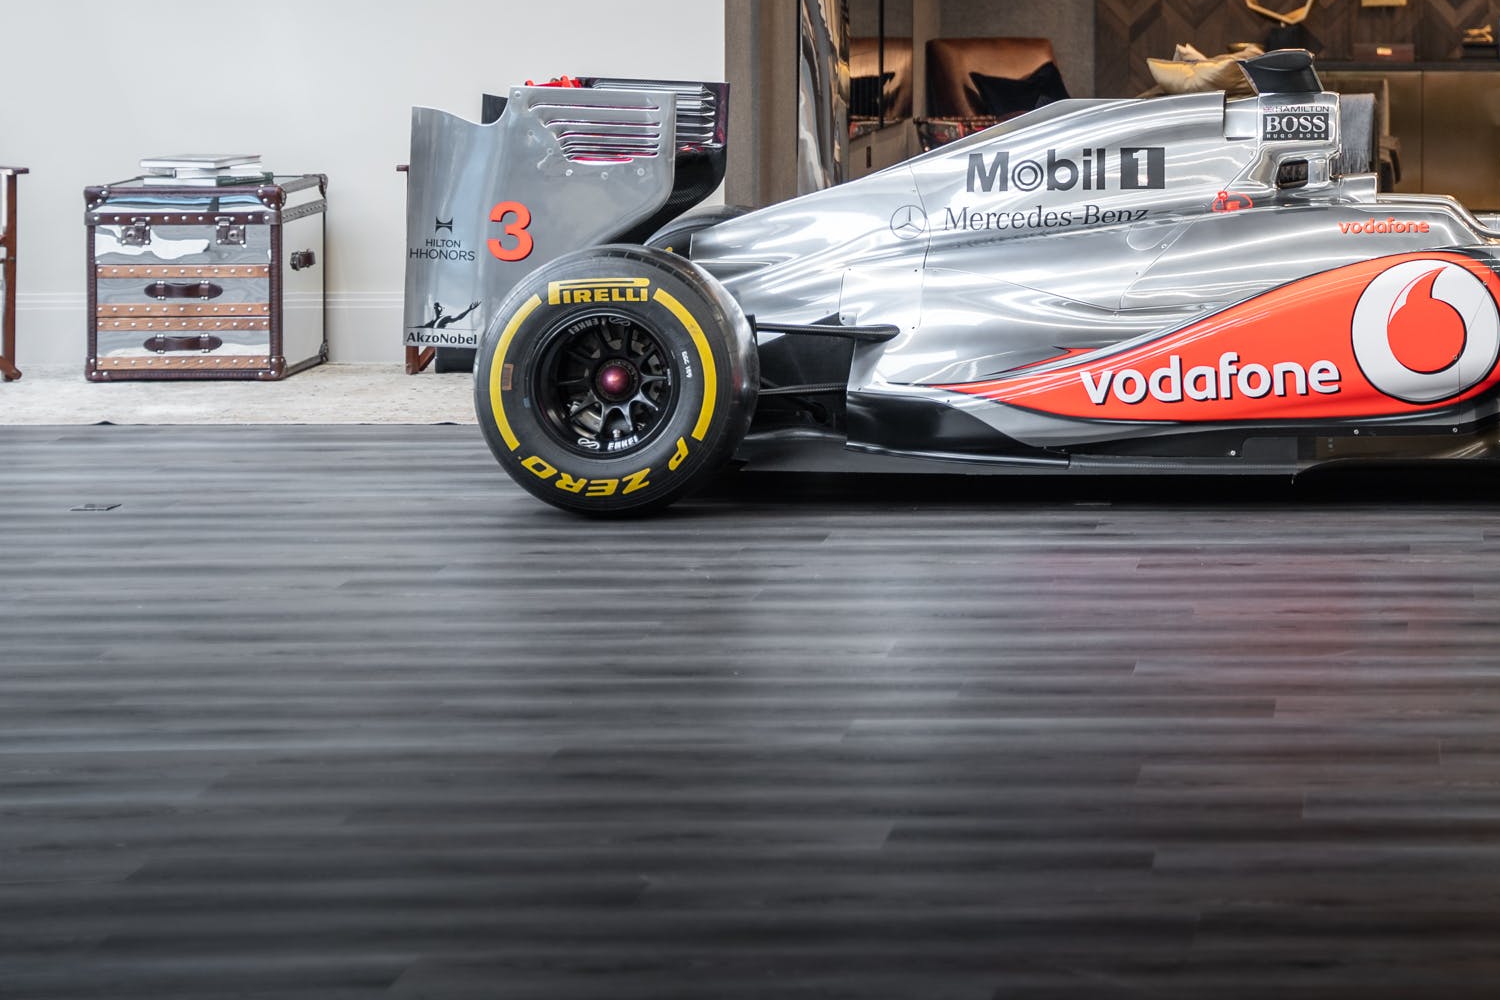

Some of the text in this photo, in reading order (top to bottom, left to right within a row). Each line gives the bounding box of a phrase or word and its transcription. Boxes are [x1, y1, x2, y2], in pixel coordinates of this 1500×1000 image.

[1265, 115, 1326, 133] BOSS
[966, 147, 1106, 193] Mobil
[943, 204, 1149, 231] Mercedes-Benz
[1338, 216, 1430, 235] vodafone
[425, 238, 461, 248] HILTON
[486, 201, 534, 262] 3
[409, 247, 476, 261] HHONORS
[547, 277, 650, 305] PIRELLI
[406, 331, 478, 345] AkzoNobel
[1080, 351, 1342, 405] vodafone
[520, 436, 690, 497] P ZERO
